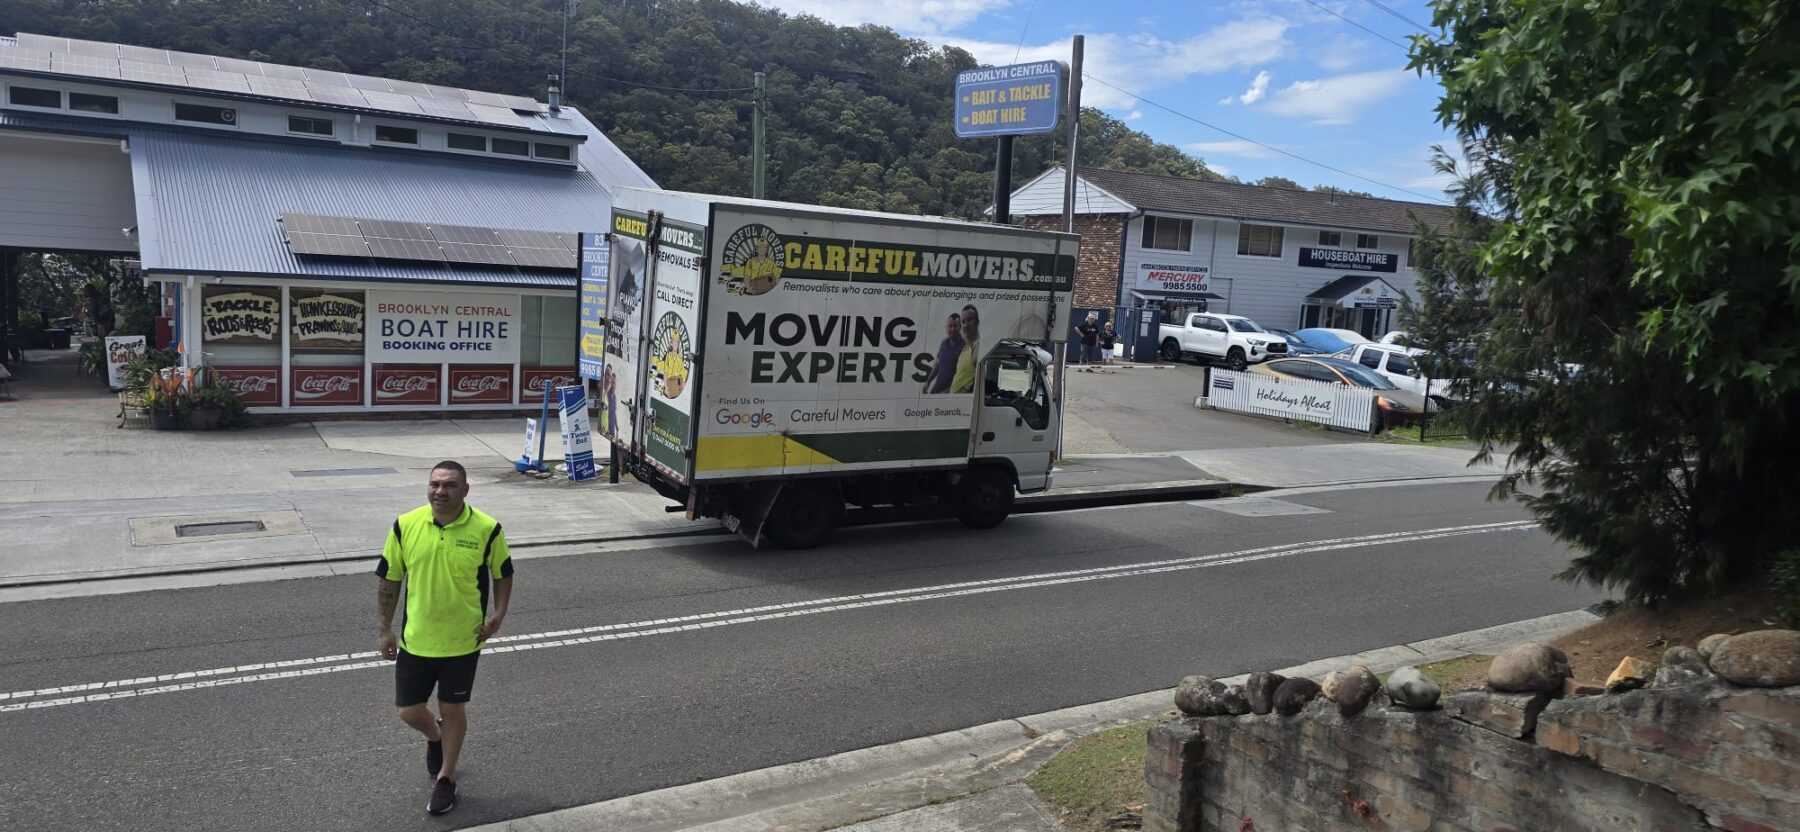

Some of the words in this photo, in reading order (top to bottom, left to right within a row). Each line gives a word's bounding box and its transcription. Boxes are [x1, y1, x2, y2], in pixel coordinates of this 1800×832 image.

[960, 69, 1008, 84] BROOKLYN
[1010, 63, 1056, 78] CENTRAL
[972, 89, 997, 106] BAIT
[998, 91, 1007, 102] &
[1009, 83, 1051, 102] TACKLE
[971, 109, 998, 126] BOAT
[1000, 107, 1027, 123] HIRE
[615, 216, 647, 237] CAREFU
[661, 226, 694, 248] MOVERS
[594, 234, 604, 246] 83
[724, 226, 758, 264] CAREFUL
[760, 227, 785, 268] MOVERS
[657, 249, 691, 269] REMOVALS
[784, 242, 1067, 284] CAREFULMOVERS.comau
[1311, 249, 1366, 263] HOUSEBOAT
[1366, 254, 1388, 265] HIRE
[1147, 271, 1205, 284] MERCURY
[1163, 282, 1185, 291] 9985
[1186, 283, 1208, 292] 5500
[656, 289, 671, 304] CALL
[671, 293, 694, 310] DIRECT
[783, 281, 839, 293] Removalists
[841, 285, 860, 294] who
[862, 286, 882, 296] care
[884, 286, 910, 297] about
[911, 288, 931, 299] your
[932, 289, 977, 301] belongings
[978, 291, 995, 300] and
[995, 292, 1020, 301] prized
[1020, 295, 1065, 303] possessons
[210, 299, 273, 314] TACKLE
[299, 300, 361, 319] HAWKESBURY
[378, 303, 449, 315] BROOKLYN
[455, 305, 512, 317] CENTRAL
[207, 314, 240, 336] RODS
[381, 318, 449, 338] BOAT
[457, 320, 509, 339] HIRE
[725, 311, 917, 348] MOVING
[109, 338, 145, 352] Great
[383, 340, 446, 350] BOOKING
[449, 341, 493, 351] OFFICE
[750, 350, 935, 384] EXPERTS
[719, 398, 738, 406] Find
[740, 398, 751, 406] Us
[753, 397, 765, 405] On
[1256, 387, 1298, 408] Holidays
[1301, 395, 1331, 411] Afloat
[716, 408, 773, 429] Google
[790, 408, 839, 422] Careful
[842, 408, 886, 421] Movers
[904, 408, 933, 418] Google
